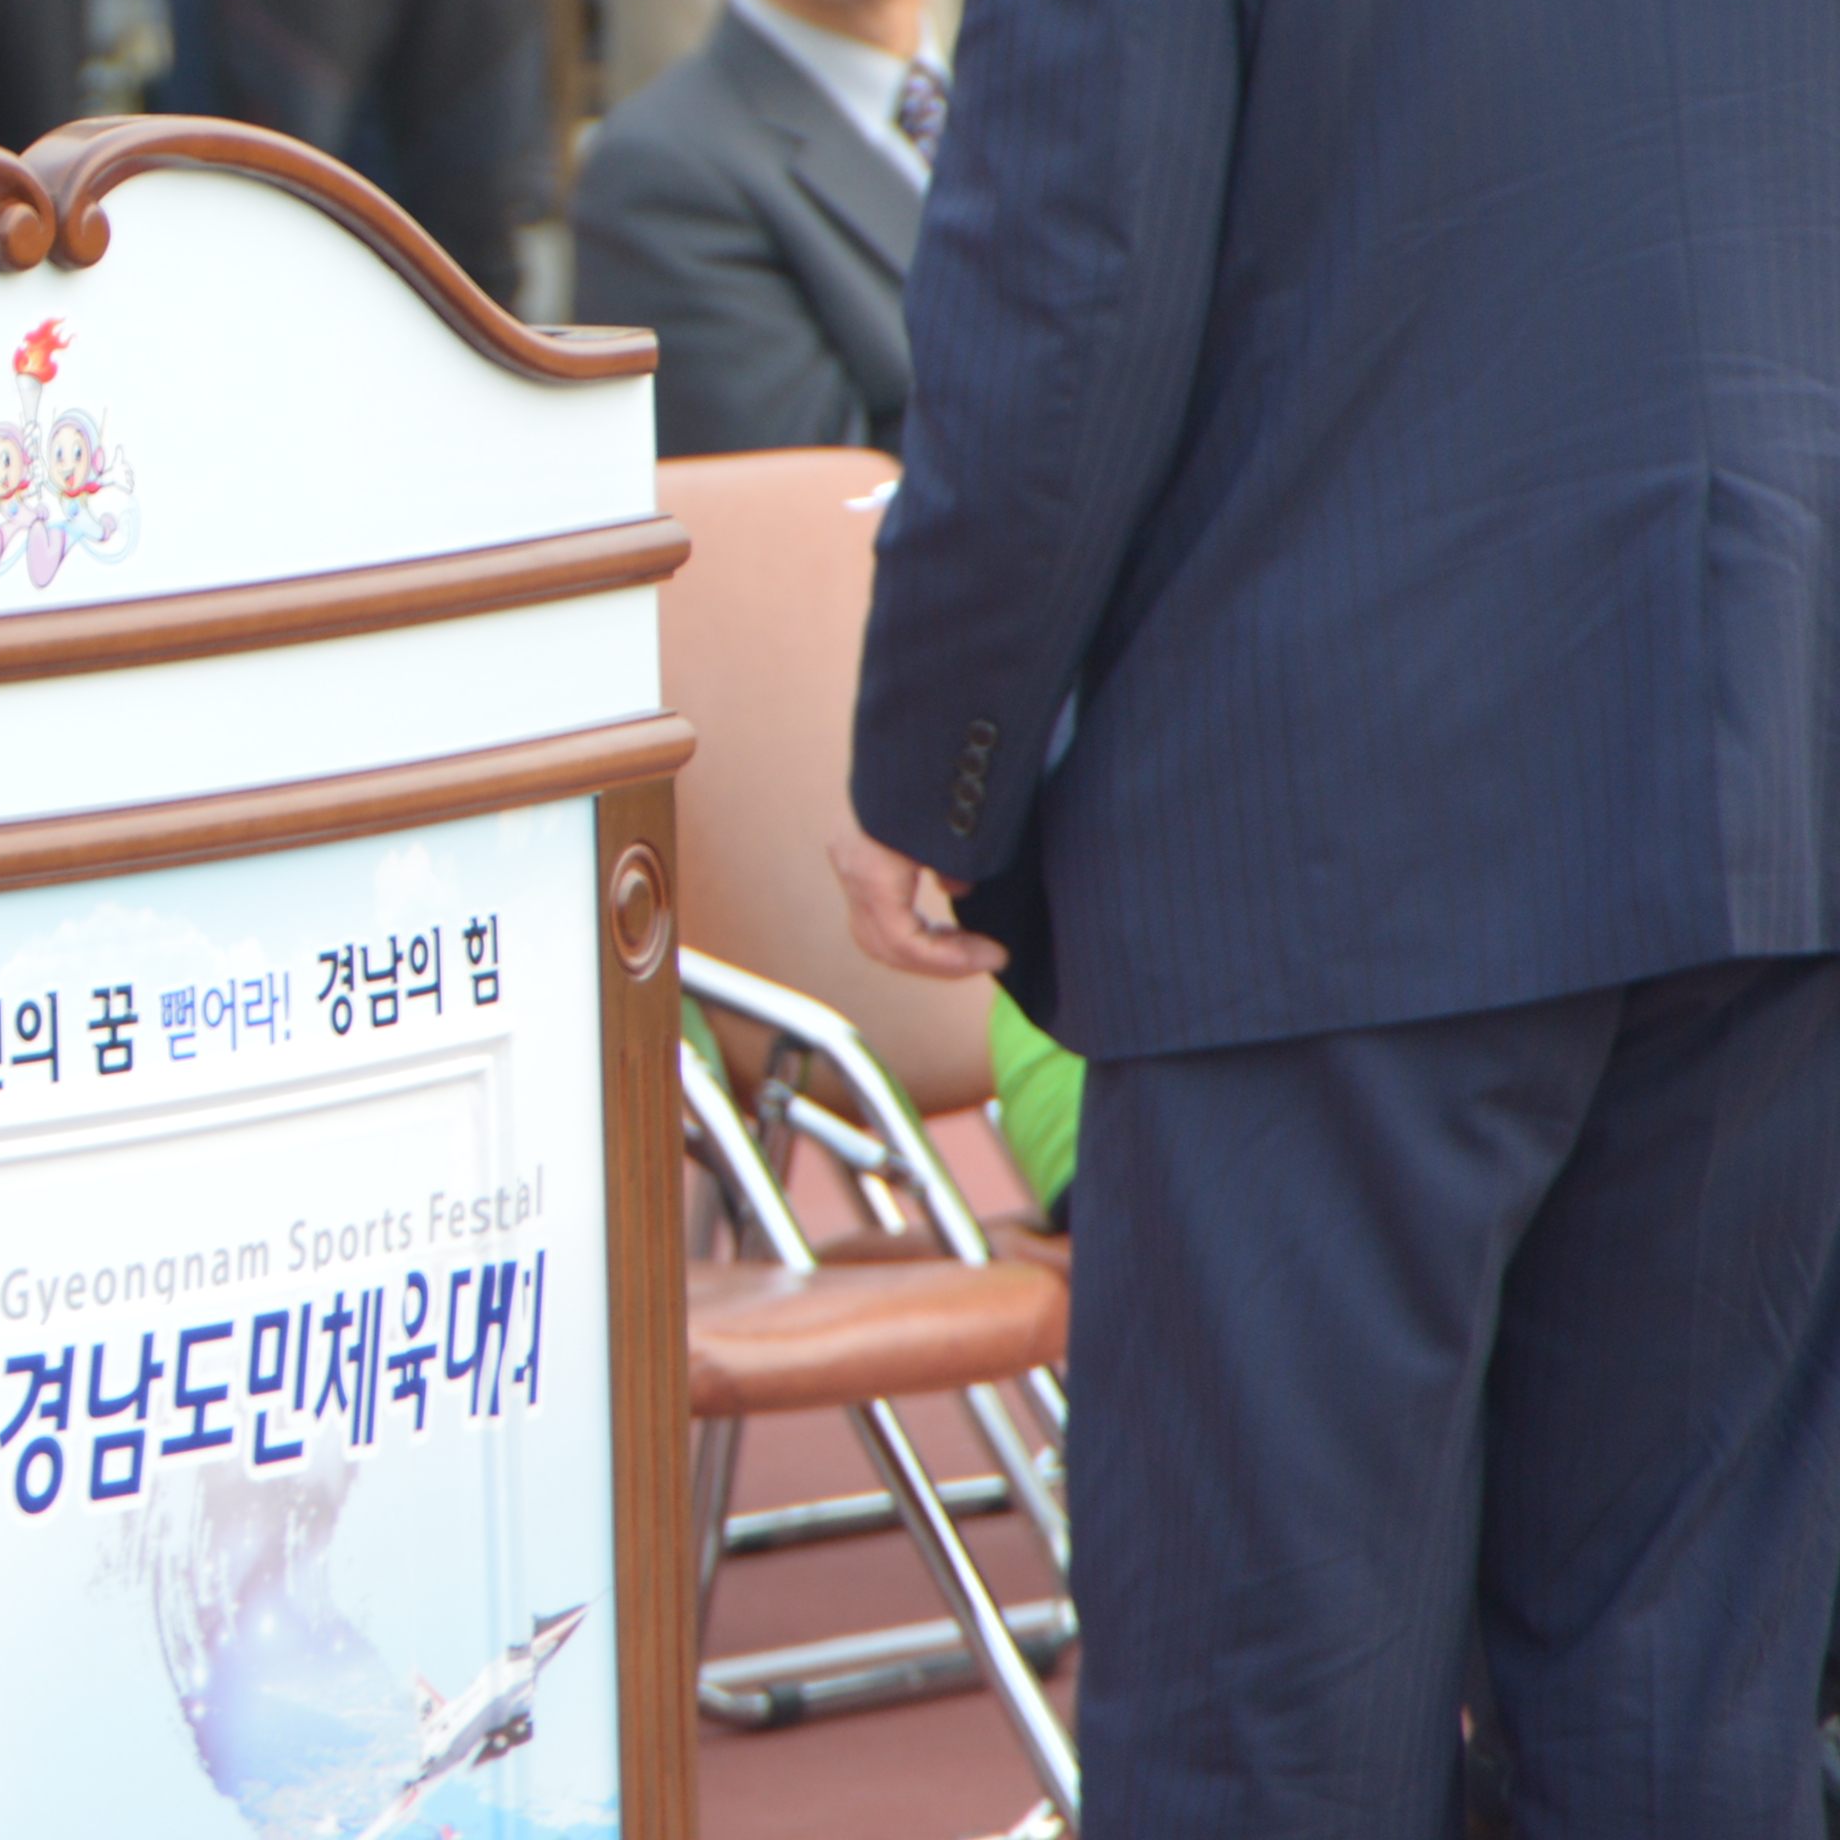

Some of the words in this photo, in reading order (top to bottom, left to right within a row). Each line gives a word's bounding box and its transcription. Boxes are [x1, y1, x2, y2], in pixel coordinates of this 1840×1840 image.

[88, 983, 139, 1076] 꿈
[317, 926, 442, 1036] 경남의
[462, 914, 499, 1006] 힘
[1, 1242, 271, 1324] Gyeongnam
[287, 1209, 413, 1273] Sports
